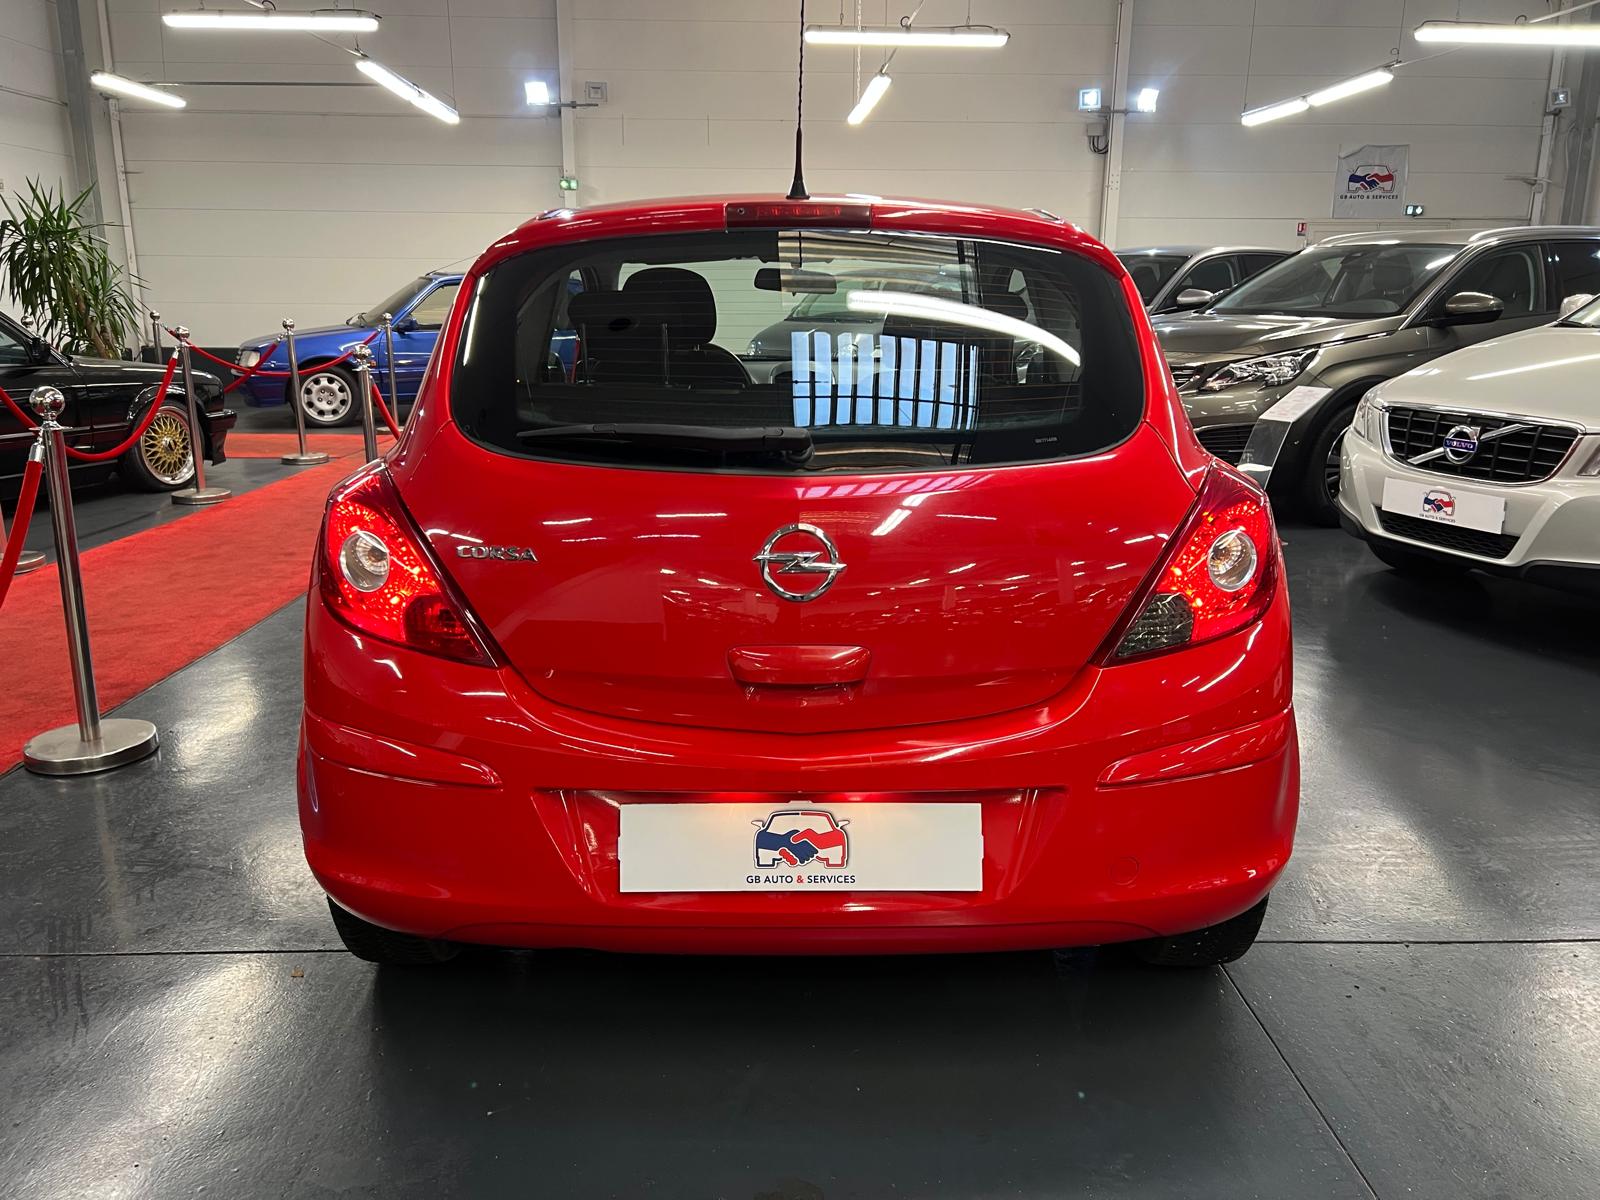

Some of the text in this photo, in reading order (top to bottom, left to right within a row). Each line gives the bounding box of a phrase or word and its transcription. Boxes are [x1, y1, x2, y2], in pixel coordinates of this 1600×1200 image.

[1446, 440, 1474, 449] VOLVO
[456, 545, 538, 562] CORSA
[746, 875, 856, 884] GB AUTO & SERVICES
